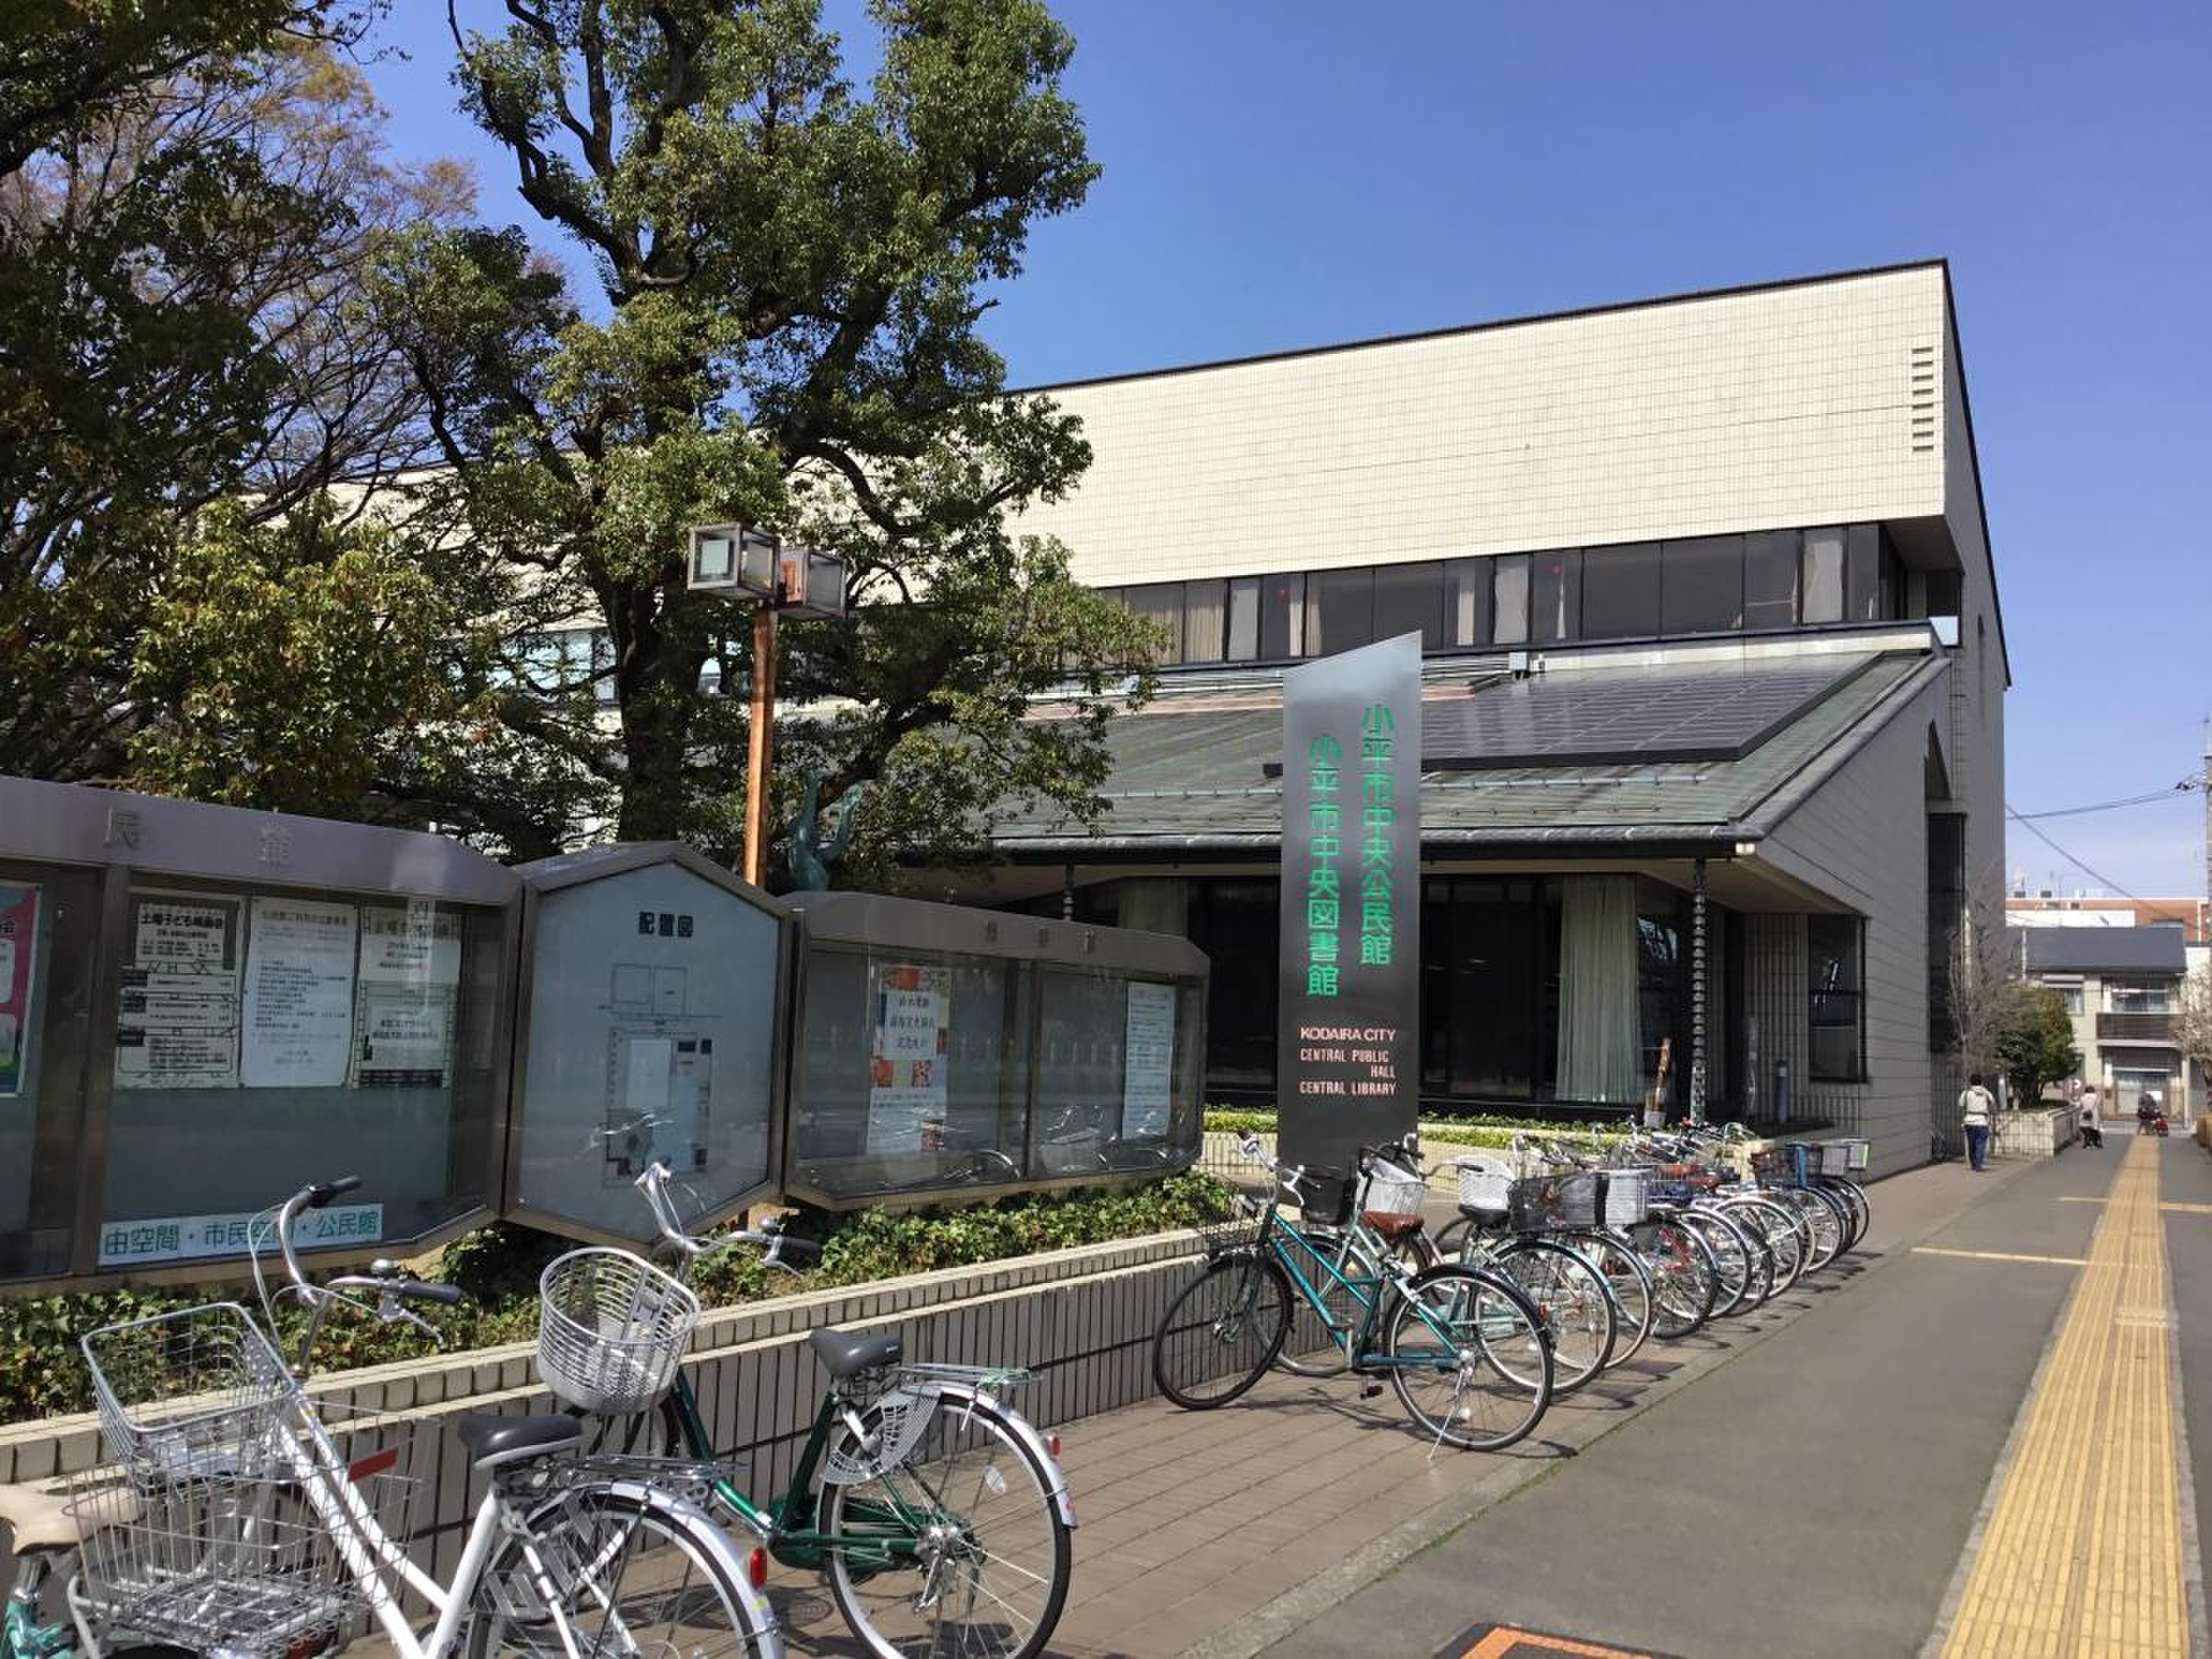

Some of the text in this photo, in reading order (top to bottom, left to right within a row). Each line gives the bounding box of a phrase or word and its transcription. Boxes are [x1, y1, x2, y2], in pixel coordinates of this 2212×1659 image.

[1359, 703, 1394, 965] 小平市中央公民館
[1306, 735, 1342, 996] 小平市中央図書館
[1300, 1027, 1396, 1041] KODAIRA CITY
[1300, 1048, 1389, 1063] CENTRAL PUBLIC
[1371, 1065, 1395, 1078] HALL
[1299, 1081, 1396, 1096] CENTRAL LIBRARY
